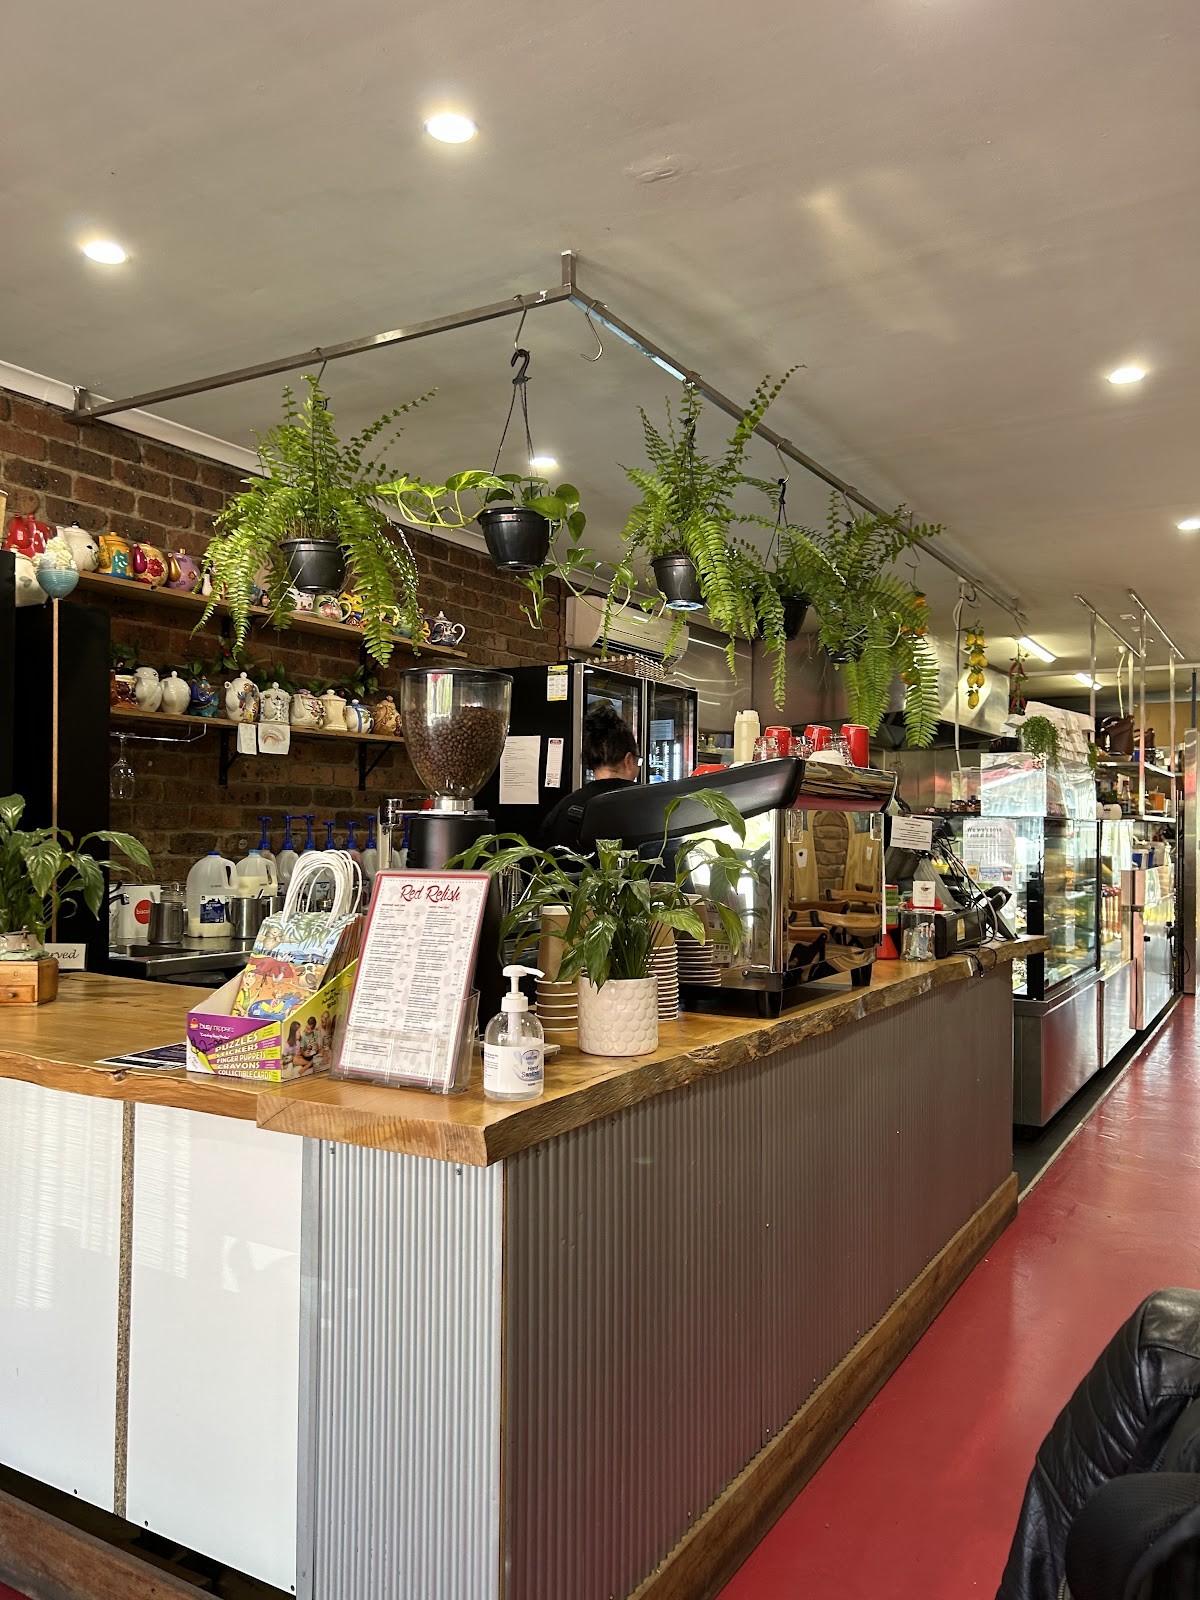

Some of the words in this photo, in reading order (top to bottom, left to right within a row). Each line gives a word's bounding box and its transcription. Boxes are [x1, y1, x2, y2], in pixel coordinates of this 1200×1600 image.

[401, 884, 424, 902] Red
[425, 884, 461, 903] Relish
[49, 948, 80, 960] rved
[214, 1031, 259, 1053] PUZZLES
[215, 1042, 259, 1059] STICKERS
[216, 1055, 239, 1064] FINGER
[240, 1050, 266, 1062] PUPPETS
[217, 1061, 260, 1070] CRAYONS
[218, 1069, 253, 1078] COLLECTIBLE
[253, 1070, 272, 1080] CARDS
